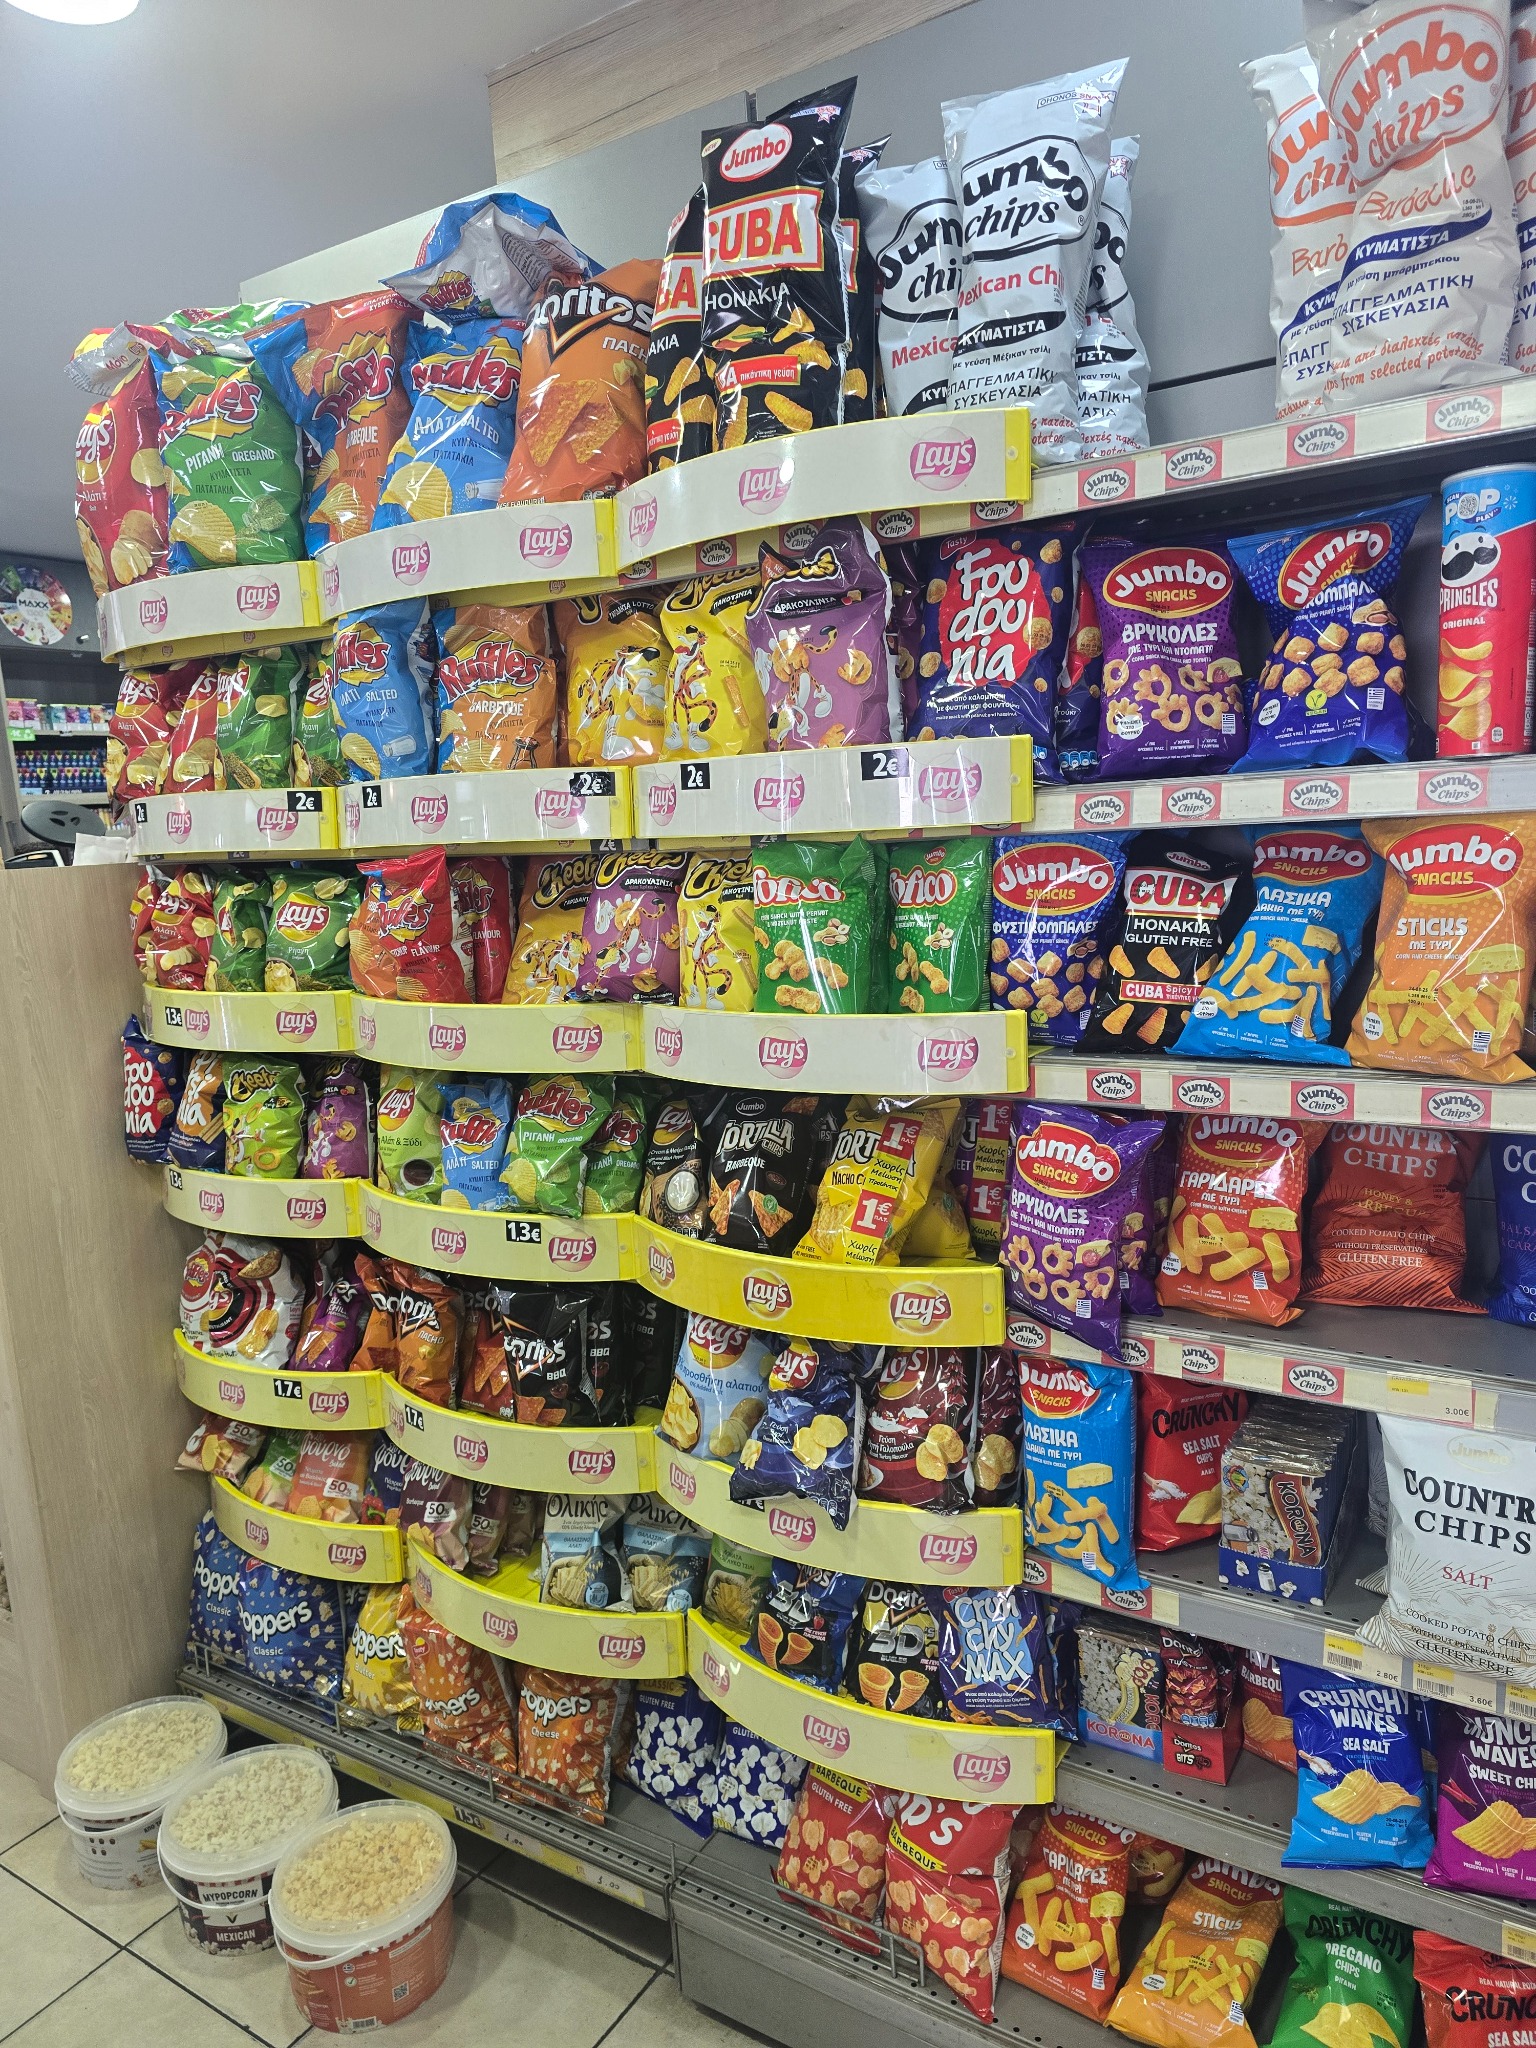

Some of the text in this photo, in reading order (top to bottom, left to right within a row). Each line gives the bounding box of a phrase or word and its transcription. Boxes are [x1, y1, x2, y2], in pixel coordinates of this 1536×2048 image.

[1369, 82, 1465, 168] chips
[703, 140, 719, 154] NEW
[724, 137, 786, 170] Jumbo
[1360, 163, 1476, 221] Barbecue
[964, 198, 1060, 244] chips
[1355, 230, 1450, 260] ΚΥΜΑΤΙΣΤΑ
[705, 282, 790, 311] HONAKIA
[1341, 295, 1450, 337] ΣΥΣΚΕΥΑΣΙΑ
[962, 319, 1046, 346] ΚΥΜΑΤΙΣΤΑ
[964, 349, 1027, 369] γεύση Μέξικαν
[1370, 354, 1424, 382] selected
[740, 364, 795, 382] πικάντικη γεύση
[954, 384, 1041, 410] ΣΥΣΚΕΥΑΣΙΑ
[1436, 397, 1492, 423] Jumbo
[232, 449, 274, 462] OREGANO
[1305, 439, 1336, 453] Chips
[919, 440, 974, 474] Lay's
[944, 537, 969, 550] Tasty
[955, 547, 1029, 600] Fou
[1284, 527, 1385, 603] Jumbo
[1115, 558, 1228, 598] Jumbo
[18, 600, 50, 610] MAXX
[241, 585, 279, 613] Lay's
[712, 589, 754, 611] ΠΑΚΟΤΙΝΙΑ
[773, 595, 837, 614] ΔΡΑΚΟΥΛΙΝΙΑ
[1145, 589, 1197, 602] SNACKS
[1439, 578, 1498, 616] PRINGLES
[141, 600, 166, 625] Lay's
[950, 599, 1025, 642] dou
[1122, 623, 1219, 643] ΒΡΥΚΟΛΕΣ
[1443, 617, 1485, 630] ORIGINAL
[946, 635, 1015, 684] nia
[1174, 644, 1213, 655] ΝΤΟΜΑΤΑ
[439, 639, 544, 703] Ruffles
[365, 689, 398, 702] SALTED
[872, 751, 899, 777] 2€
[581, 773, 602, 794] 2€
[687, 766, 703, 787] 2€
[1424, 774, 1483, 797] Jumbo
[295, 794, 315, 810] 2€
[366, 787, 378, 806] 2€
[756, 776, 803, 810] Lay's
[1437, 787, 1471, 801] Chips
[411, 795, 447, 824] Lay's
[1169, 851, 1210, 872] Jumbo
[1391, 836, 1516, 874] Jumbo
[999, 857, 1109, 892] Jumbo
[1273, 861, 1328, 876] SNACKS
[1411, 872, 1474, 886] SNACKS
[1026, 888, 1076, 901] SNACKS
[1134, 874, 1228, 909] CUBA
[277, 902, 329, 930] Lay's
[154, 925, 176, 936] Αλάτι
[1133, 919, 1211, 935] HONAKIA
[1396, 917, 1468, 936] STICKS
[411, 944, 440, 954] FLAVOUR
[1125, 934, 1214, 948] GLUTEN FREE
[1409, 940, 1451, 950] ΜΕ ΤΥΡΙ
[1125, 983, 1192, 999] CUBA Spicy
[276, 1010, 315, 1036] Lay's
[1091, 1075, 1133, 1091] Jumbo
[1102, 1085, 1126, 1095] Chips
[378, 1087, 414, 1117] Lay's
[515, 1082, 596, 1126] Ruffles
[737, 1101, 764, 1113] Jumbo
[403, 1138, 422, 1147] Ξύδι
[522, 1132, 555, 1142] ΡΙΓΑΝΗ
[716, 1119, 794, 1159] TORTILLA
[1214, 1139, 1263, 1153] SNACKS
[762, 1139, 792, 1156] CHIPS
[472, 1160, 499, 1170] SALTED
[725, 1156, 766, 1172] BARBEQUE
[874, 1159, 905, 1176] Χωρίς
[1019, 1138, 1114, 1182] Jumbo
[1343, 1147, 1438, 1178] CHIPS
[832, 1171, 854, 1186] NACHO
[870, 1169, 902, 1183] Μείωση
[1032, 1164, 1078, 1185] SNACKS
[1364, 1187, 1401, 1204] HONEY
[1011, 1189, 1090, 1225] ΒΡΥΚΟΛΕΣ
[507, 1223, 540, 1242] 1,3€
[1047, 1222, 1085, 1236] ΝΤΟΜΑΤΑ
[1331, 1228, 1436, 1243] COOKED POTATO CHIPS
[1334, 1242, 1371, 1251] WITHOUT
[1338, 1253, 1423, 1268] GLUTEN FREE
[895, 1293, 947, 1326] Lay's
[589, 1347, 610, 1357] BBQ
[547, 1368, 566, 1381] BBQ
[684, 1368, 764, 1394] προσθήκη αλατιού
[312, 1392, 347, 1414] Lay's
[1032, 1389, 1071, 1407] SNACKS
[1152, 1392, 1241, 1439] CRUNCHY
[1445, 1407, 1470, 1417] 3.00€
[879, 1440, 915, 1453] Γαλοπούλα
[1182, 1434, 1221, 1456] SEA SALT
[1195, 1453, 1214, 1464] CHIPS
[1276, 1480, 1319, 1559] KORONA
[1414, 1510, 1532, 1556] CHIPS
[1442, 1565, 1494, 1591] SALT
[947, 1587, 965, 1598] Tasty
[206, 1603, 231, 1617] Classic
[1406, 1607, 1532, 1651] COOKED POTATO CHIPS
[253, 1645, 284, 1656] Classic
[1415, 1639, 1516, 1677] GLUTEN FREE
[354, 1663, 376, 1680] Butter
[964, 1651, 1028, 1683] MAX
[1376, 1670, 1398, 1683] 2.80€
[638, 1695, 675, 1710] GLUTEN FREE
[1299, 1689, 1409, 1714] CRUNCHY
[1469, 1695, 1494, 1707] 3.60€
[1330, 1709, 1399, 1735] WAVES
[531, 1728, 560, 1740] Cheese
[1086, 1718, 1155, 1749] KORONA
[1343, 1737, 1390, 1755] SEA SALT
[1176, 1753, 1194, 1765] BITS
[815, 1763, 864, 1798] BARBEQUE
[1469, 1763, 1512, 1786] SWEET
[811, 1782, 854, 1815] GLUTEN FREE
[1064, 1820, 1108, 1846] SNACKS
[1207, 1877, 1253, 1902] SNACKS
[1192, 1910, 1243, 1931] STICKS
[216, 1930, 256, 1943] MEXICAN
[1325, 1943, 1382, 1974] OREGANO
[1335, 1960, 1361, 1978] CHIPS
